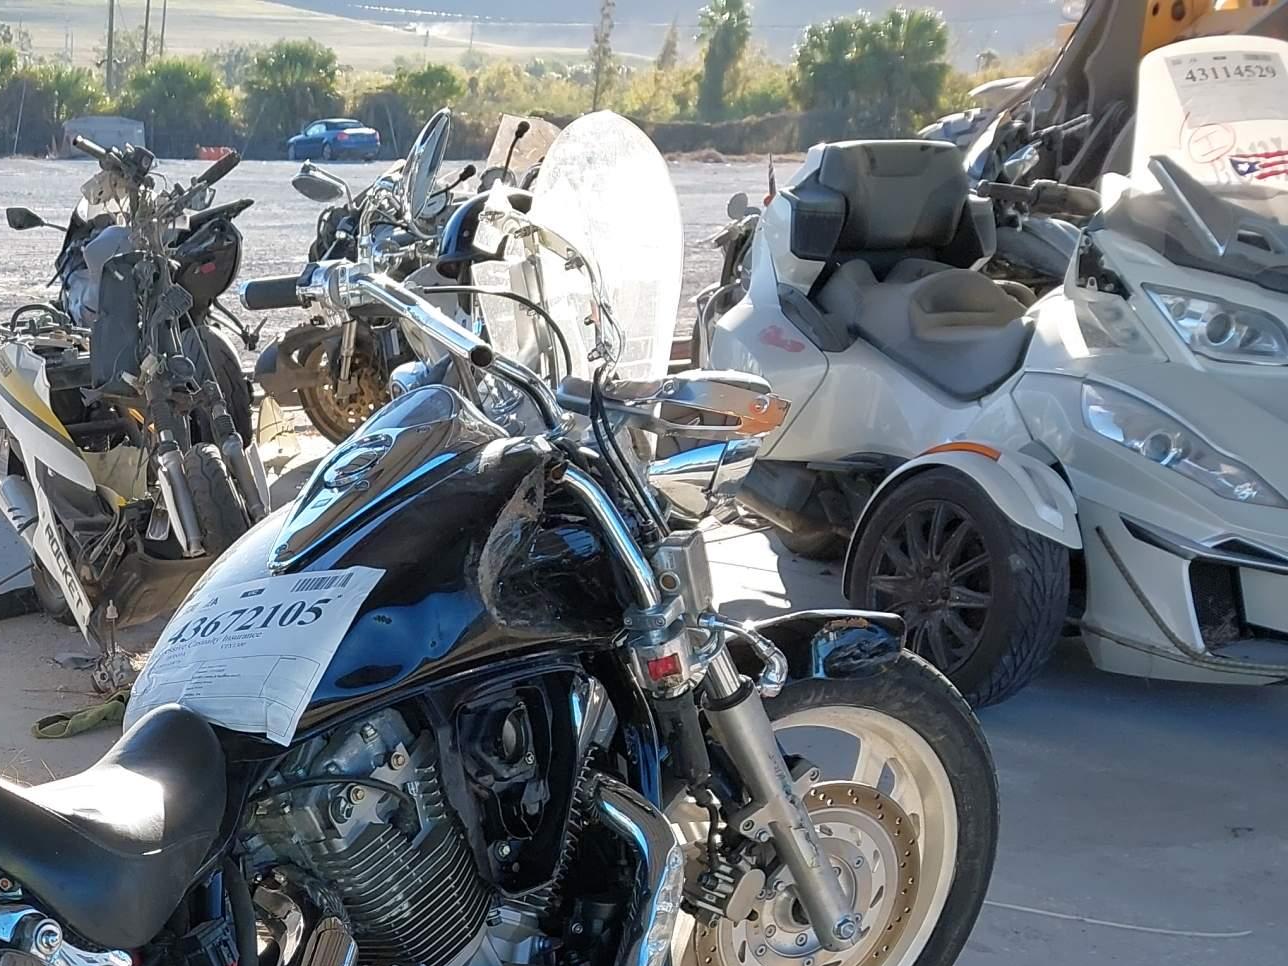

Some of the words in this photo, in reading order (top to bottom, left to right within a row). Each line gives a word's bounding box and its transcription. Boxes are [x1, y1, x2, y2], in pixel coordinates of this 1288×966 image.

[1185, 65, 1277, 82] 43114529
[45, 523, 84, 608] ROCKET
[167, 598, 332, 645] 43672105
